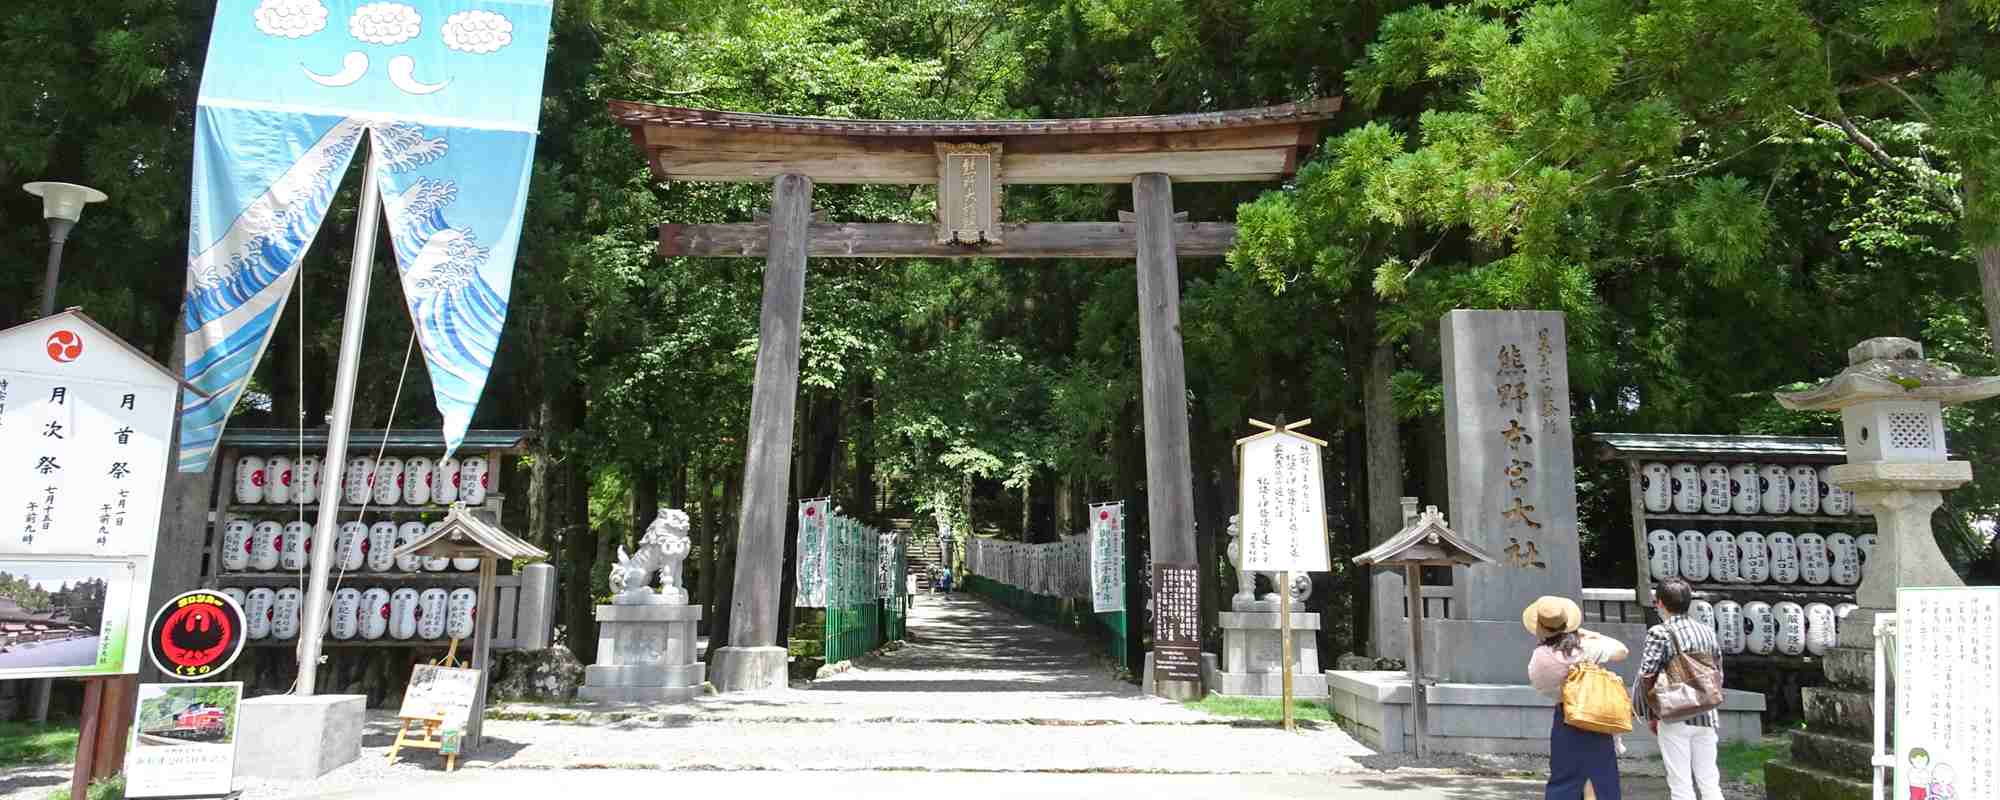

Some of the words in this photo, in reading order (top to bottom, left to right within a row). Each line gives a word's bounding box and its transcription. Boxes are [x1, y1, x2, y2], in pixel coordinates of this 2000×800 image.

[35, 386, 66, 475] 月次祭
[109, 394, 135, 479] 月首祭
[1496, 344, 1546, 568] 熊野本宮大社
[22, 502, 39, 544] 午前九時
[42, 486, 57, 530] 七月十五日
[97, 504, 113, 546] 午前九時
[115, 488, 130, 526] 七月一日
[176, 665, 211, 676] くまの
